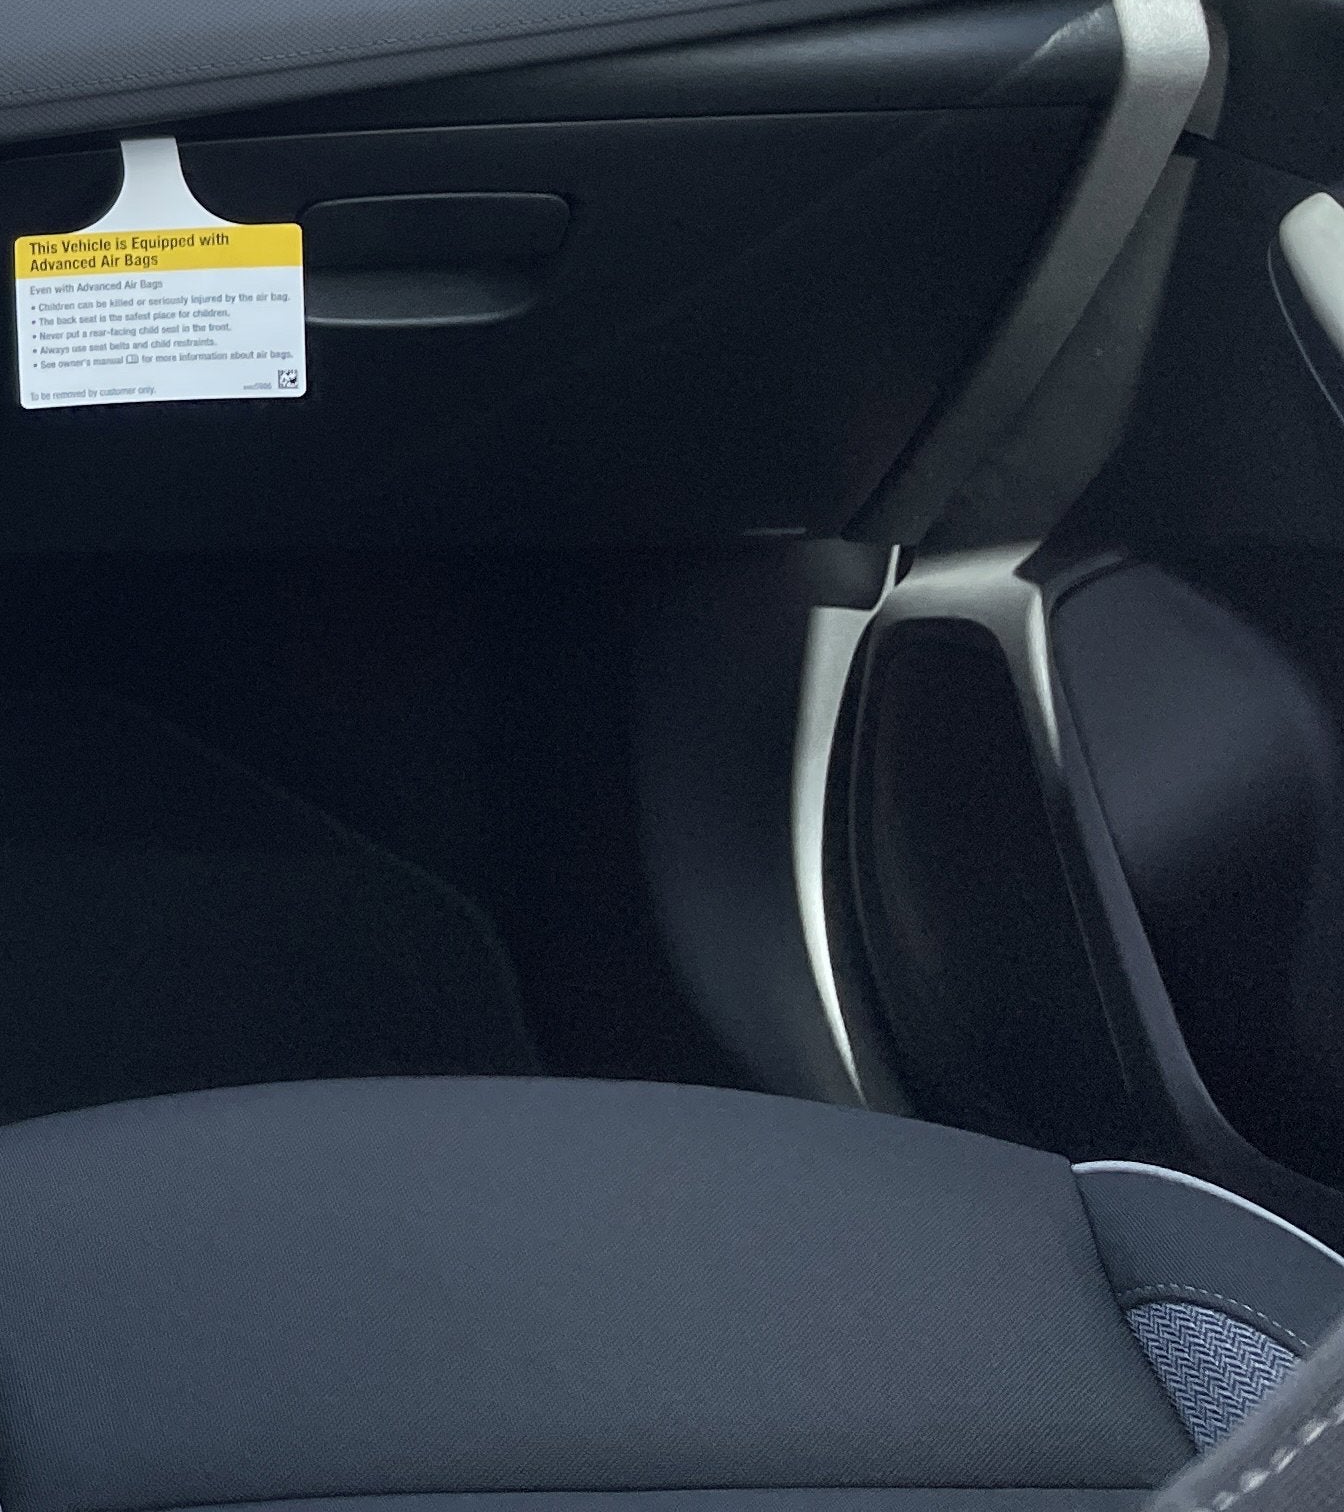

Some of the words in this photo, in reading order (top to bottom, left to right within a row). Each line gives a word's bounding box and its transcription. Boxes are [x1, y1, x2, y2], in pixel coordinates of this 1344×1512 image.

[30, 241, 57, 255] This
[62, 238, 111, 253] Vehicle
[116, 237, 127, 250] is
[132, 235, 194, 252] Equipped
[199, 233, 229, 247] with
[31, 257, 96, 272] Advanced
[101, 255, 120, 267] Air
[125, 254, 158, 268] Bags
[30, 286, 51, 295] Even
[55, 284, 74, 293] with
[77, 282, 121, 292] Advanced
[125, 281, 137, 289] Air
[140, 280, 162, 289] Bags
[39, 303, 74, 311] Children
[78, 301, 93, 309] can
[96, 300, 106, 308] be
[110, 299, 133, 307] killed
[149, 295, 188, 305] seriously
[191, 295, 222, 304] injured
[225, 294, 235, 303] by
[256, 293, 267, 301] air
[271, 292, 289, 302] bag.
[57, 316, 76, 325] back
[79, 315, 96, 323] seat
[100, 314, 106, 322] is
[109, 313, 122, 321] the
[125, 312, 150, 321] safest
[153, 311, 175, 320] place
[40, 332, 63, 340] Never
[66, 330, 79, 339] put
[139, 326, 159, 334] child
[162, 325, 179, 333] seat
[193, 323, 205, 331] the
[40, 347, 69, 355] Always
[90, 343, 107, 351] seat
[110, 342, 129, 350] belts
[133, 340, 148, 348] and
[151, 340, 170, 348] child
[41, 361, 55, 369] See
[59, 359, 90, 368] owner's
[93, 356, 123, 365] manual
[180, 352, 227, 361] information
[230, 351, 254, 359] about
[257, 350, 267, 358] air
[41, 391, 50, 399] be
[53, 389, 86, 398] removed
[89, 388, 97, 397] by
[100, 386, 136, 396] customer
